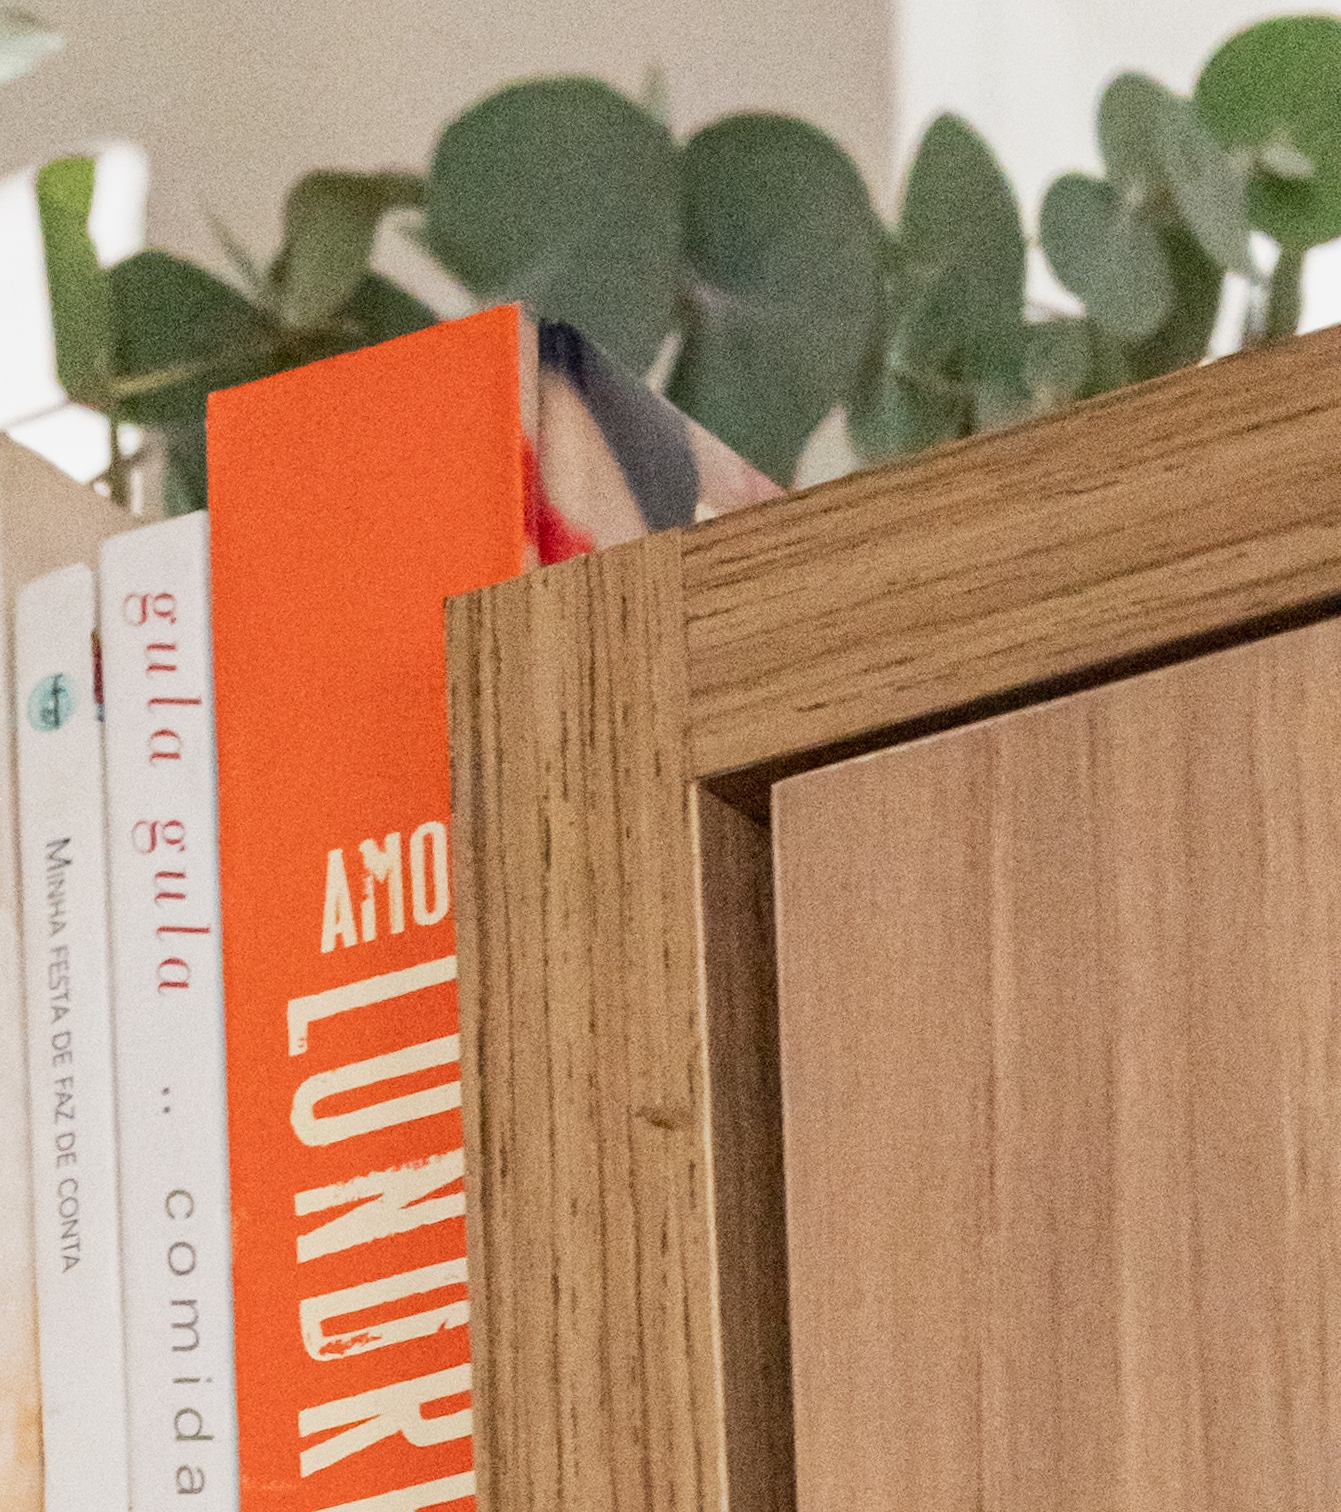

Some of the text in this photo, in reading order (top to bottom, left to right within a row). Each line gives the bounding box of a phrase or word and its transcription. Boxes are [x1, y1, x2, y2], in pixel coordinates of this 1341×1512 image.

[122, 591, 203, 767] gula
[131, 820, 212, 994] gula
[320, 820, 451, 954] AMO
[50, 1029, 74, 1069] DE
[53, 1075, 76, 1125] FAZ
[54, 1130, 79, 1170] DE
[57, 1176, 82, 1274] CONTA
[163, 1187, 215, 1497] comida
